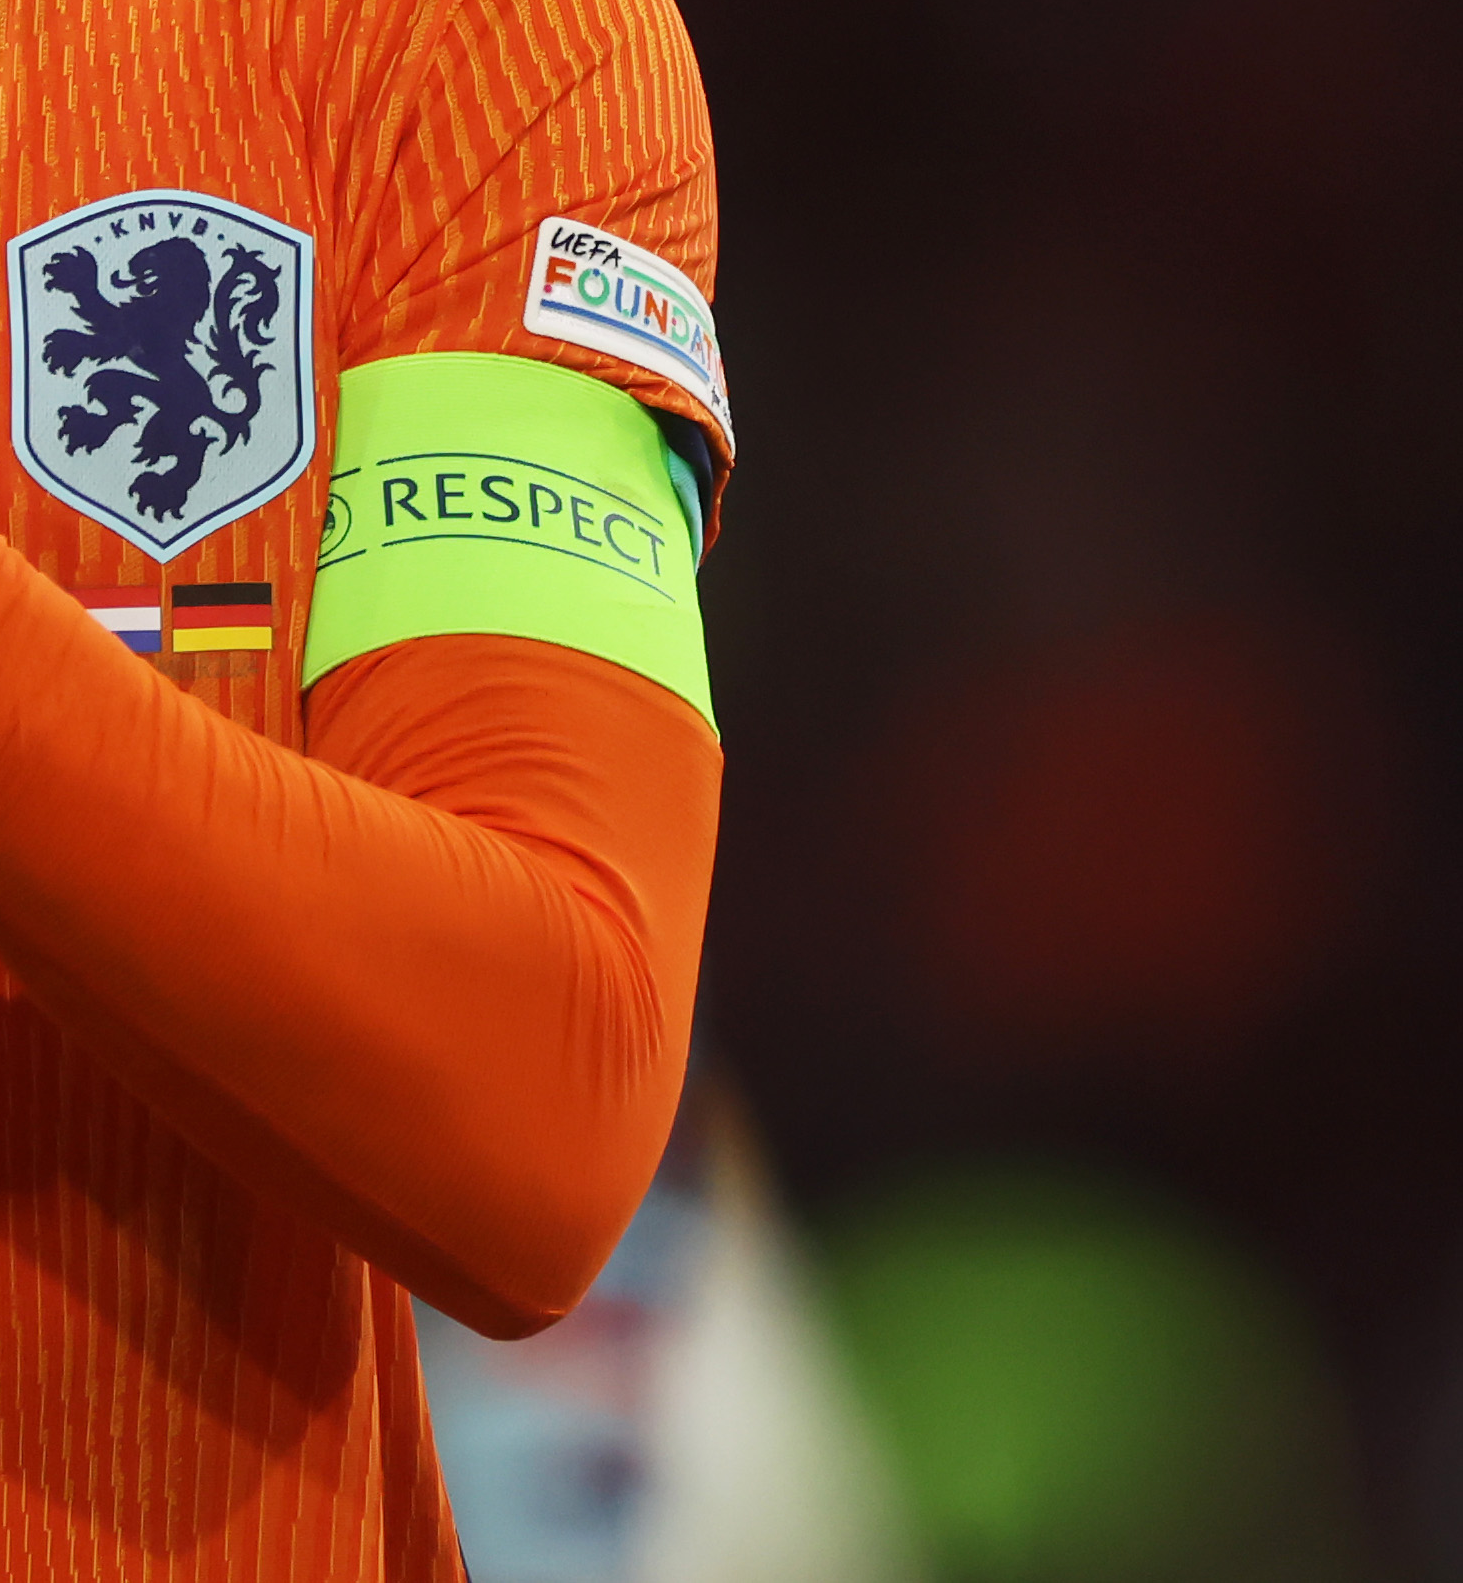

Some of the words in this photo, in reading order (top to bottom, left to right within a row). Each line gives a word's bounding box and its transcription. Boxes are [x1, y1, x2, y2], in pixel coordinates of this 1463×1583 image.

[110, 212, 209, 238] KNVB
[551, 226, 622, 268] UEFA
[543, 256, 724, 386] FOUNDAT
[382, 472, 665, 577] RESPECT
